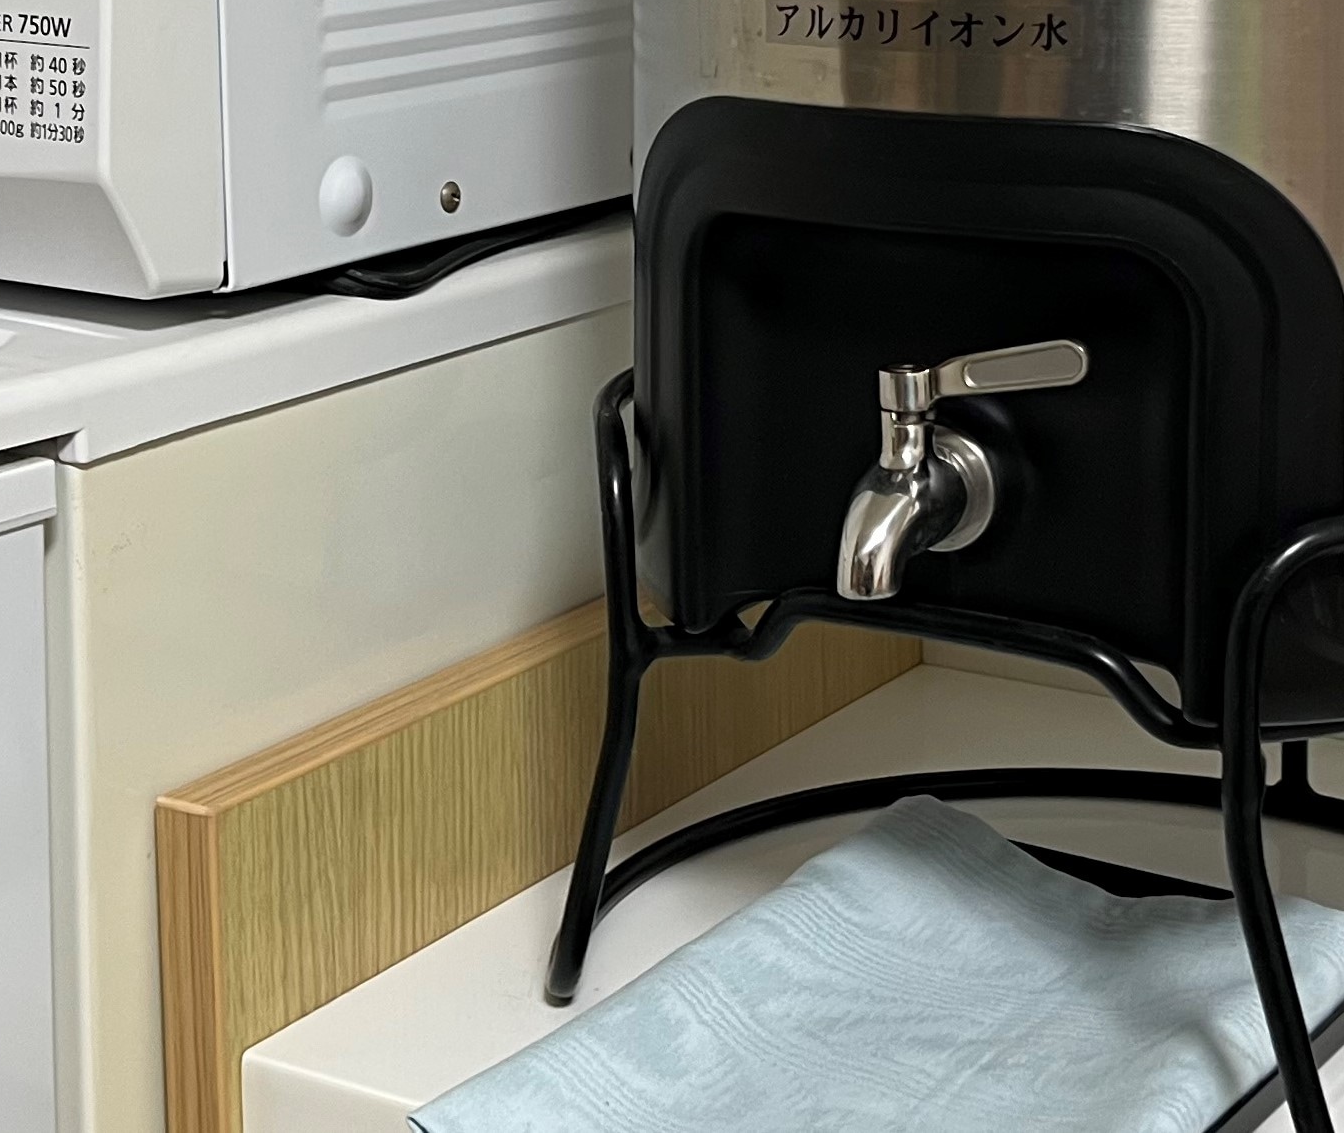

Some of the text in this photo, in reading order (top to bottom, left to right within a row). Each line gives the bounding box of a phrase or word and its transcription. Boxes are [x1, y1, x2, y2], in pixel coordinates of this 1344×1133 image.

[18, 14, 71, 38] 750W
[776, 4, 1068, 51] アルカリイオン水
